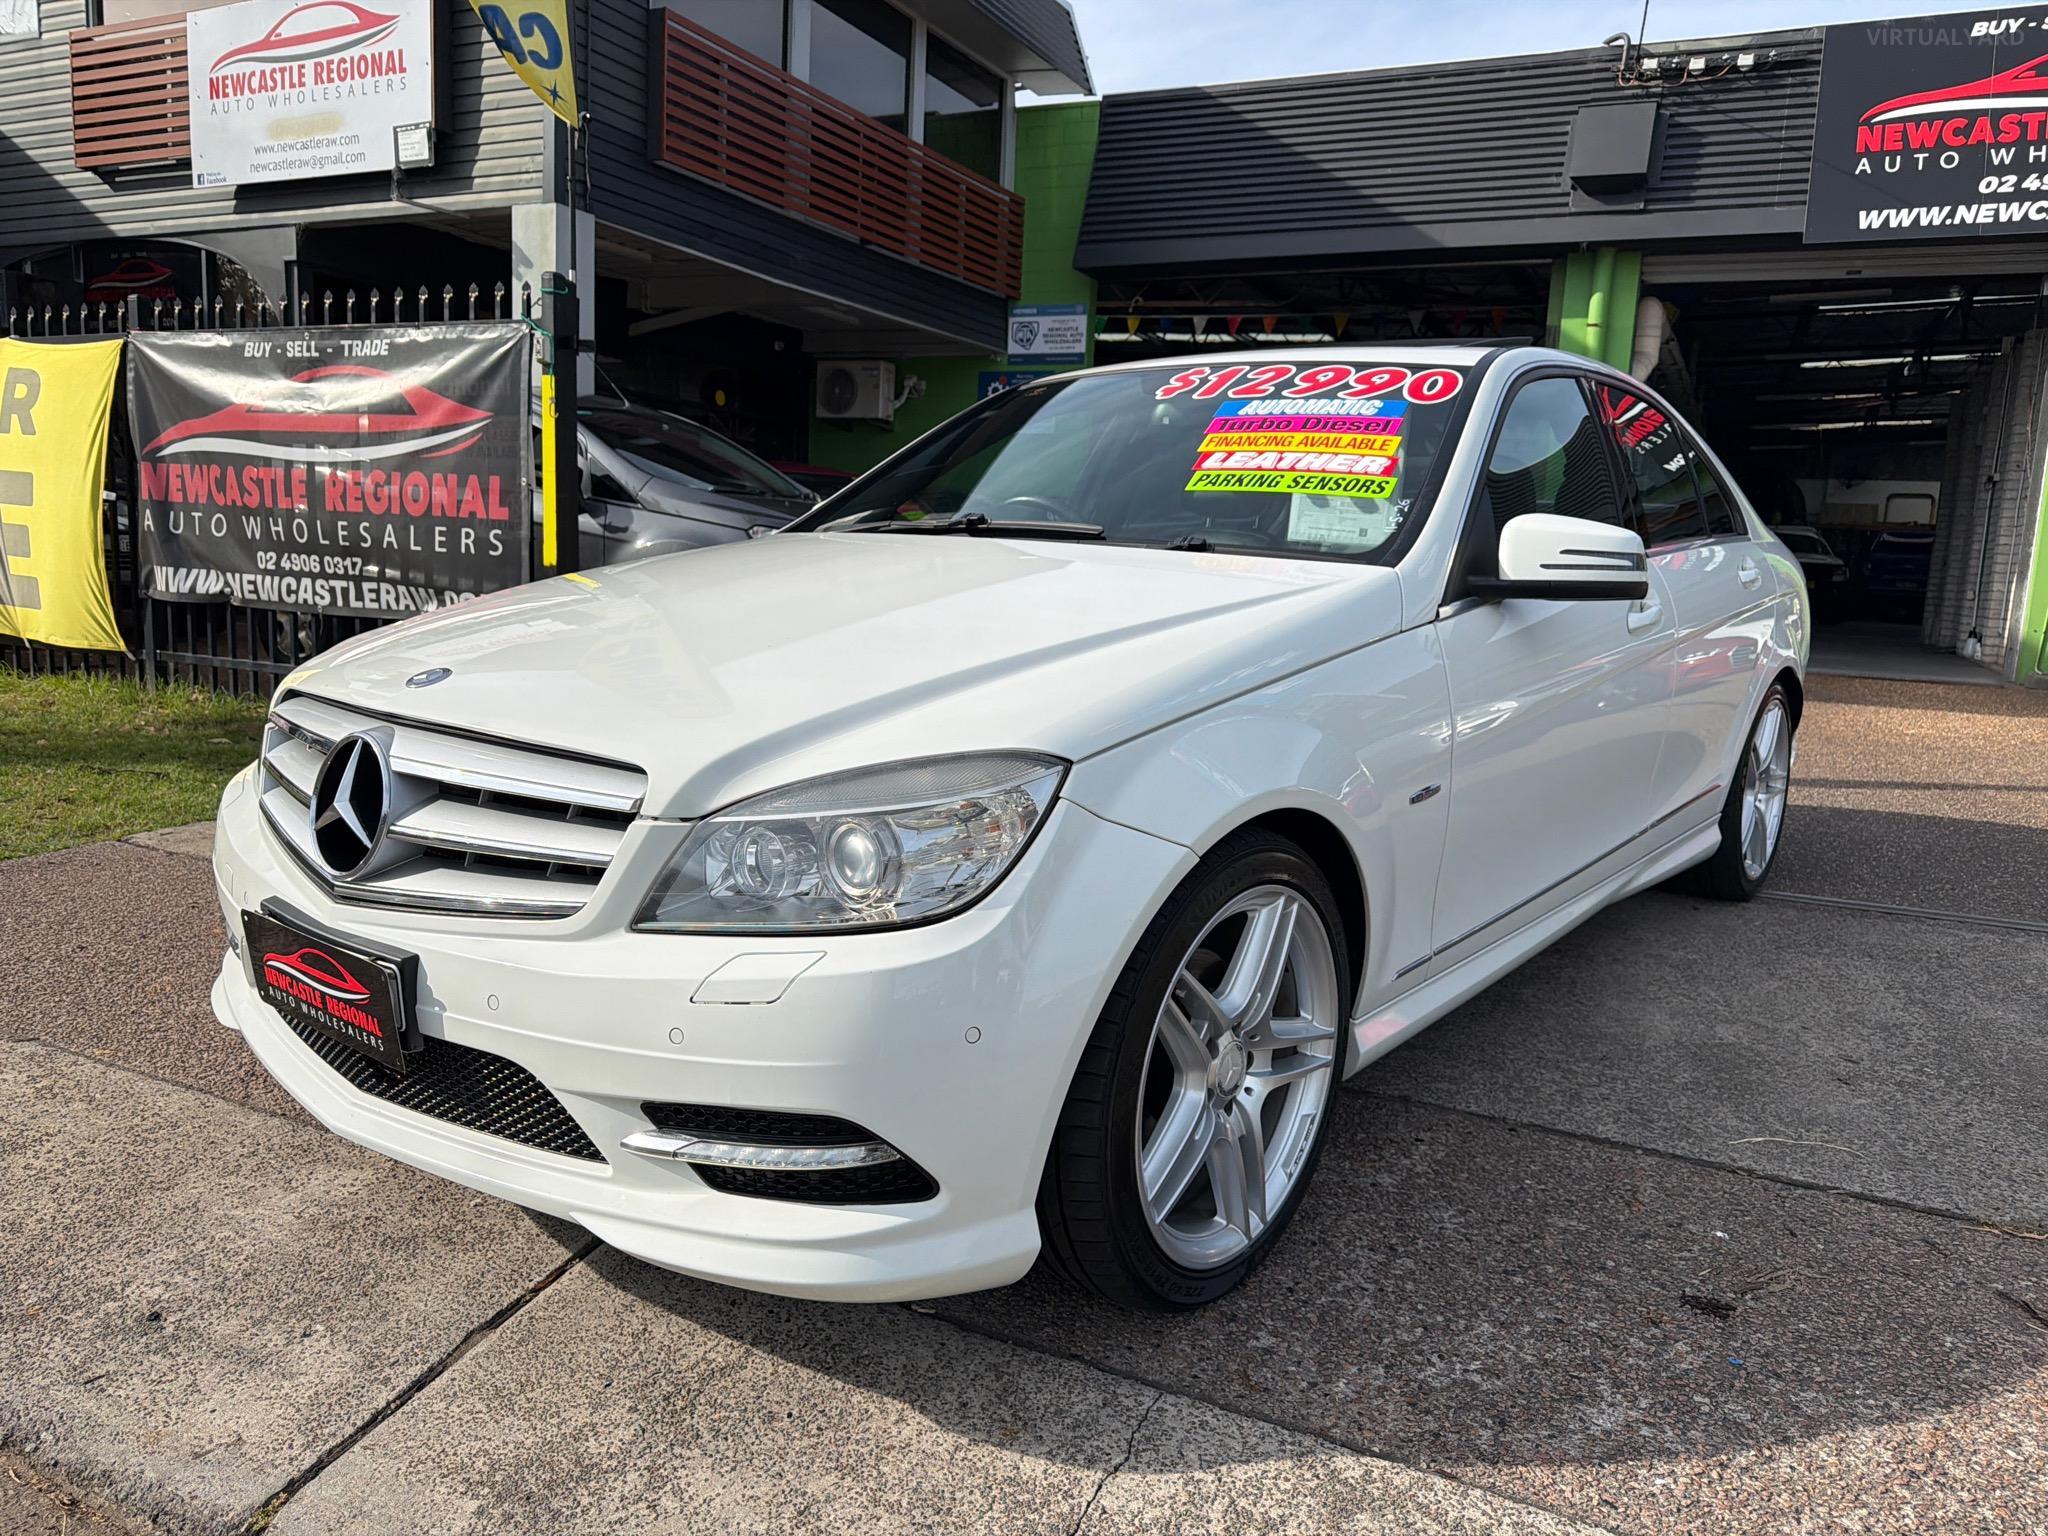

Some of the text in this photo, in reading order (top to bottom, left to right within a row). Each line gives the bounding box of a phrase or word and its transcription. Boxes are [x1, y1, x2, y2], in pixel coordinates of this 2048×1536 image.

[1970, 17, 2026, 37] BUY
[209, 48, 407, 100] NEWCASTLE REGIONAL
[210, 76, 407, 116] AUTO WHOLESALERS
[254, 132, 360, 155] www.newcastleraw.com
[1855, 111, 2048, 153] NEWCAST
[249, 150, 366, 174] newcastleraw@gmail.com
[1855, 151, 1960, 175] AUTO
[1978, 174, 2018, 194] 02
[1858, 200, 2048, 230] WWW.NEWC
[244, 341, 272, 358] BUY
[286, 340, 320, 358] SELL
[340, 338, 391, 357] TRADE
[1155, 365, 1464, 404] $12990
[1237, 399, 1384, 416] AUTOMATIC
[1218, 416, 1392, 434] Turbo Diesel
[1205, 434, 1394, 452] FINANCING AVAILABLE
[1201, 451, 1392, 475] LEATHER
[140, 461, 510, 521] NEWCASTLE REGIONAL
[1193, 473, 1390, 495] PARKING SENSORS
[144, 508, 504, 556] AUTO WHOLESALERS
[257, 551, 362, 576] 02 4906 0317
[263, 966, 383, 1038] NEWCASTLE REGIONAL
[268, 986, 384, 1051] AUTO WHOLESALERS
